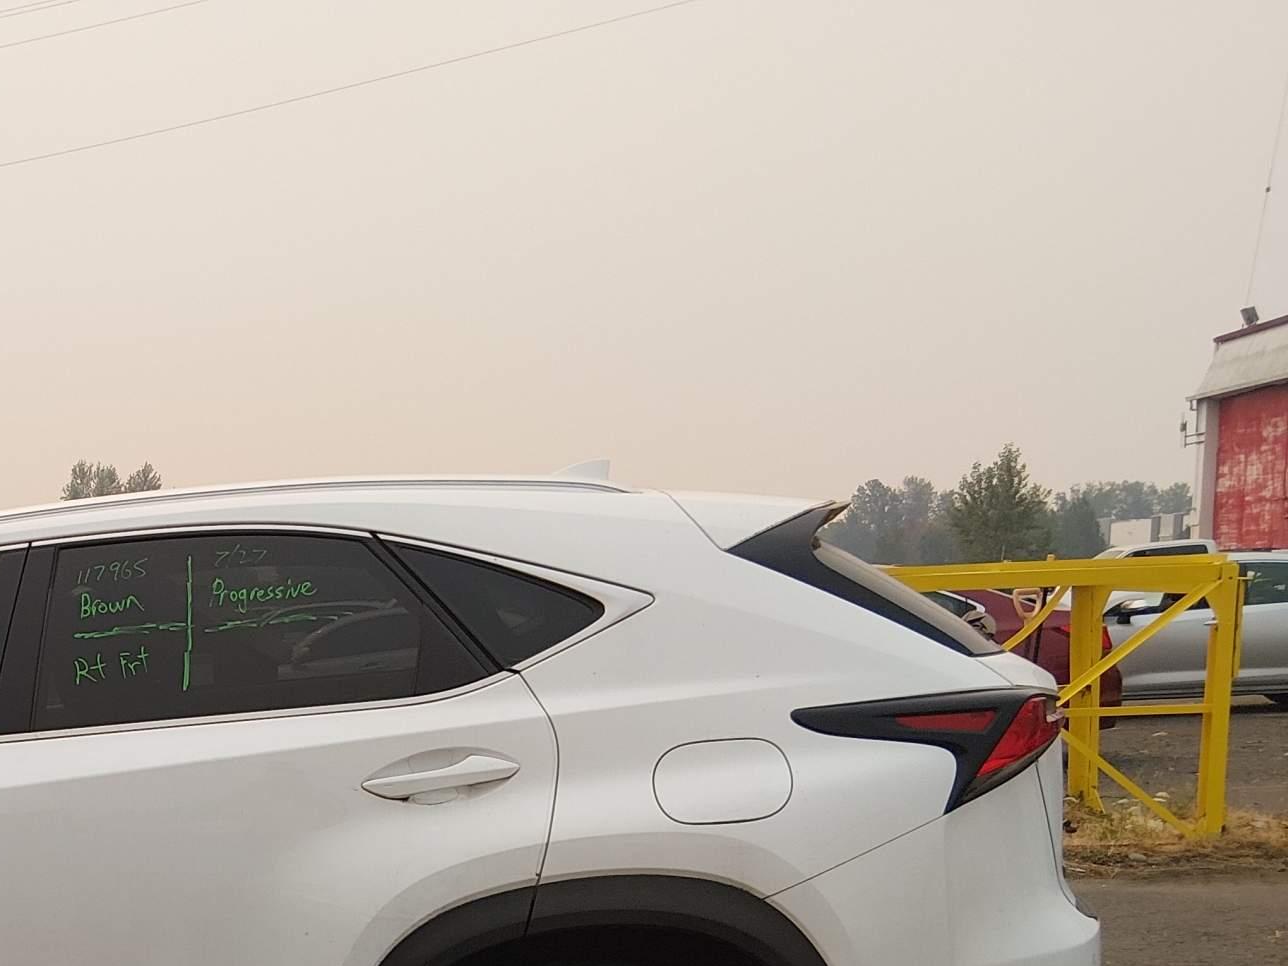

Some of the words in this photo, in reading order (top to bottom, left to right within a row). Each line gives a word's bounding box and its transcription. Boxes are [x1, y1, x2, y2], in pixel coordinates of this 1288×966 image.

[77, 557, 148, 585] 117965
[80, 592, 145, 619] Brown
[209, 577, 317, 614] Progressive
